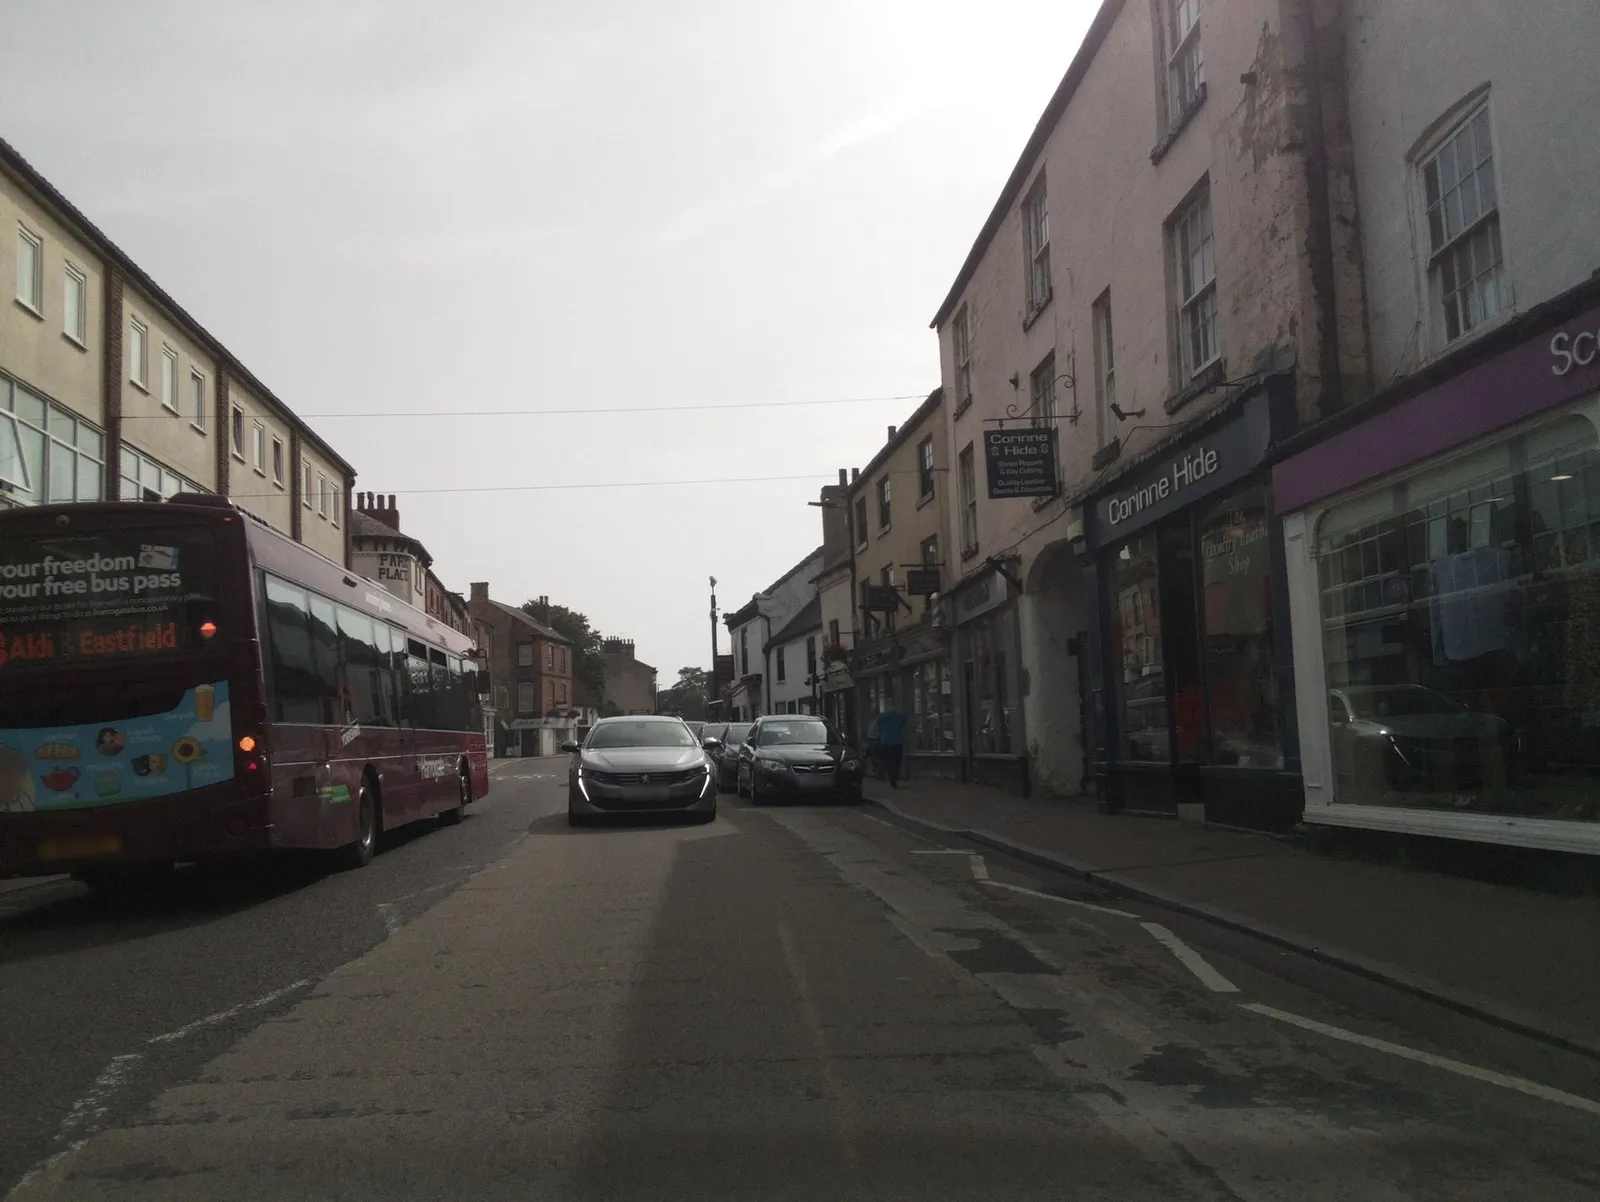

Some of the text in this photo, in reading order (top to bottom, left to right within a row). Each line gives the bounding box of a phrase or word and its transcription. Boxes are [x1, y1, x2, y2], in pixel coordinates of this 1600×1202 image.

[1550, 329, 1600, 375] SC
[990, 434, 1048, 445] Corinne
[1004, 445, 1037, 456] Hide
[1108, 447, 1218, 525] Corinne Hide
[42, 552, 135, 576] freedom
[42, 576, 87, 596] free
[90, 573, 129, 593] bus
[133, 572, 181, 593] pass
[79, 621, 176, 655] Eastfield
